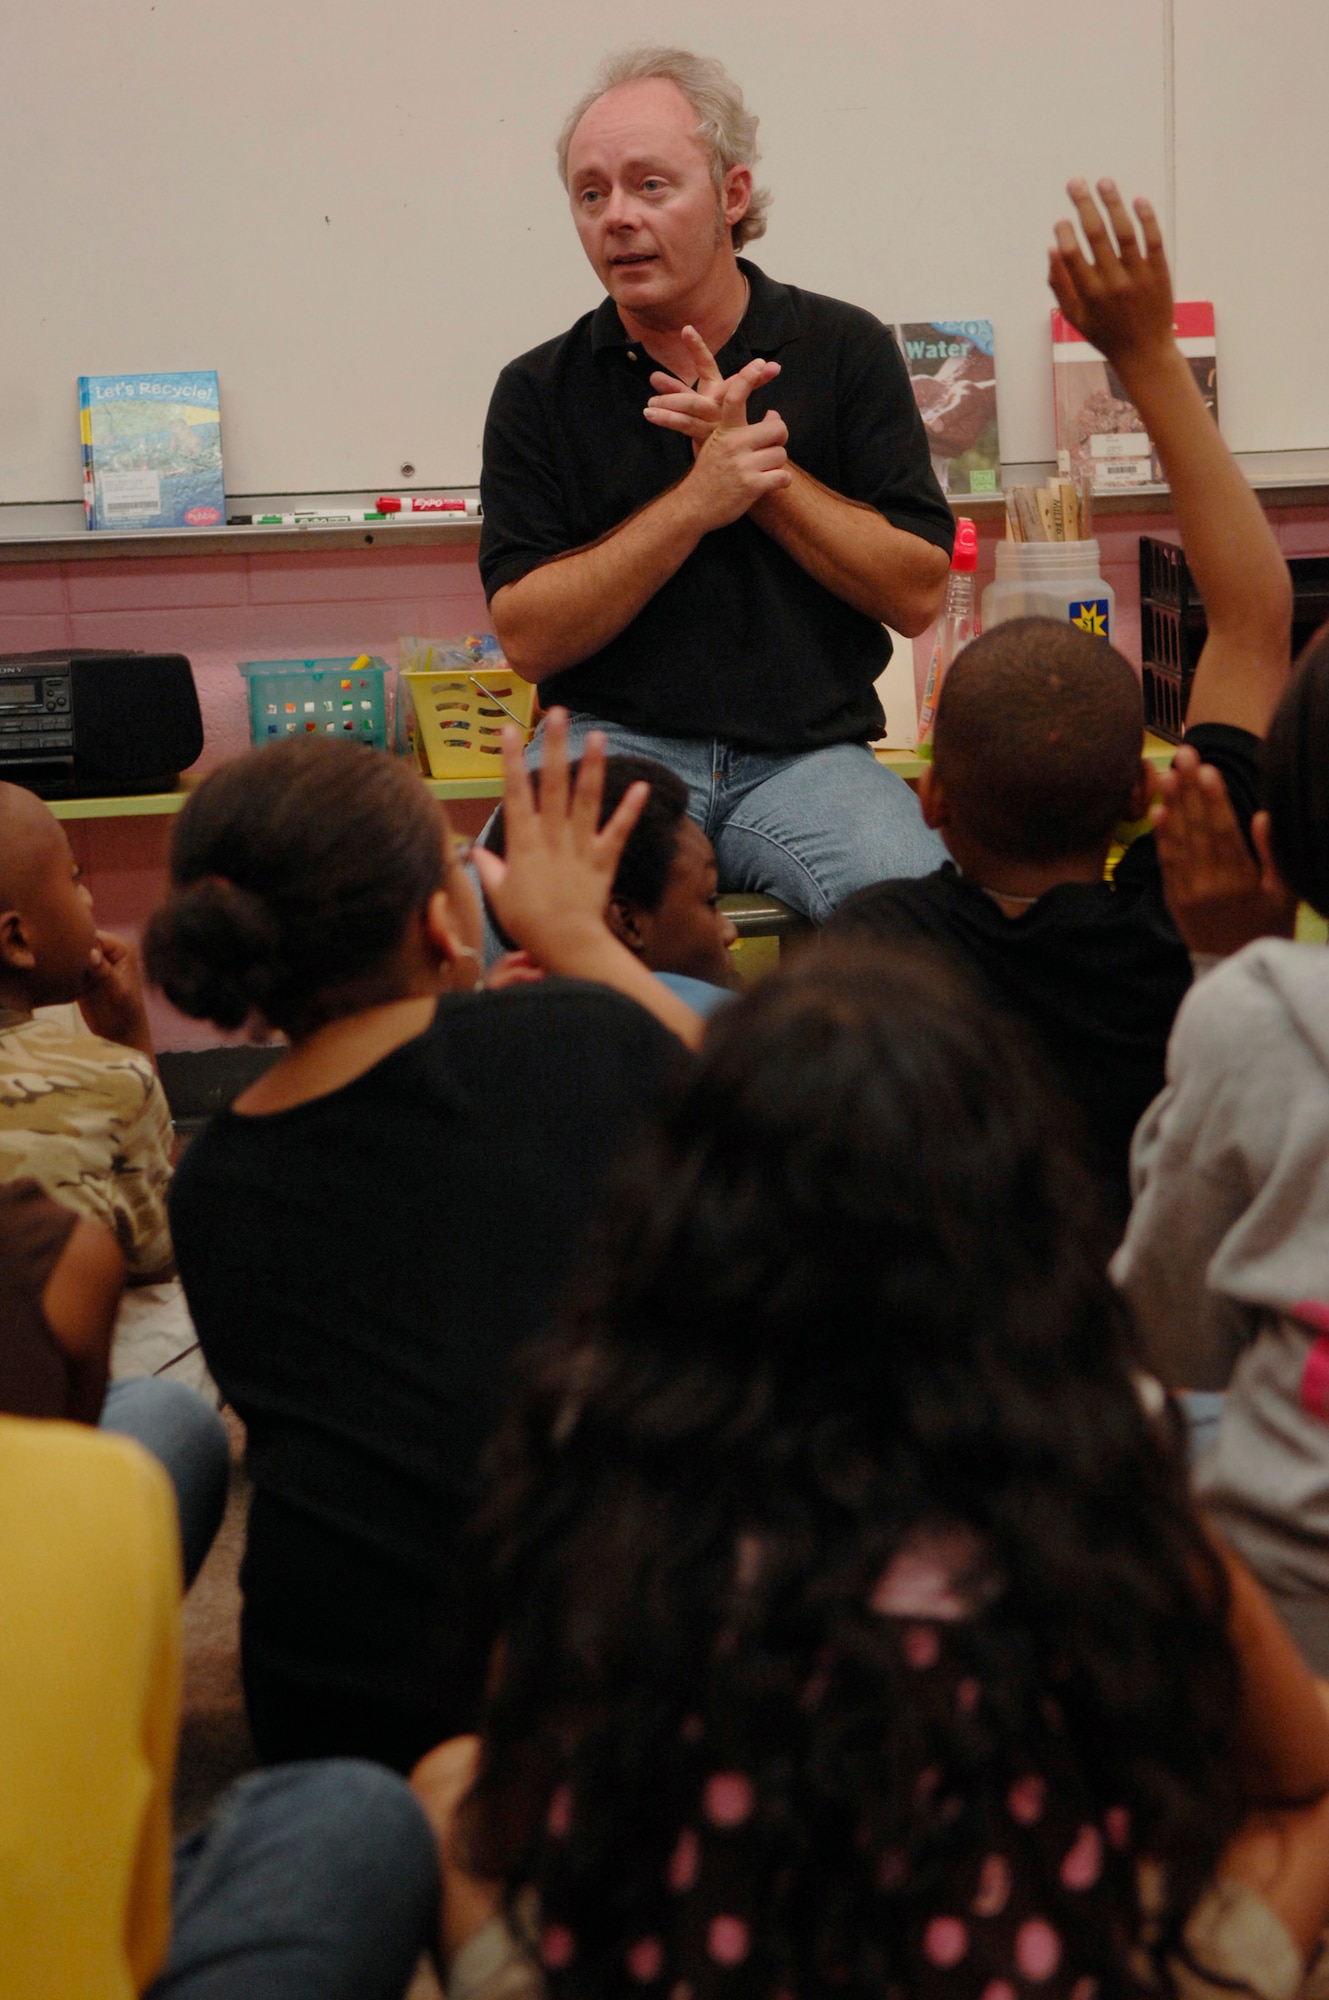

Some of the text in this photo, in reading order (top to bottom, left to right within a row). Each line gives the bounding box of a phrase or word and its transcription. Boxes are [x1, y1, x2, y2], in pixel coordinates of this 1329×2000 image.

[905, 340, 971, 360] Water
[95, 381, 212, 400] Let's Recycle!
